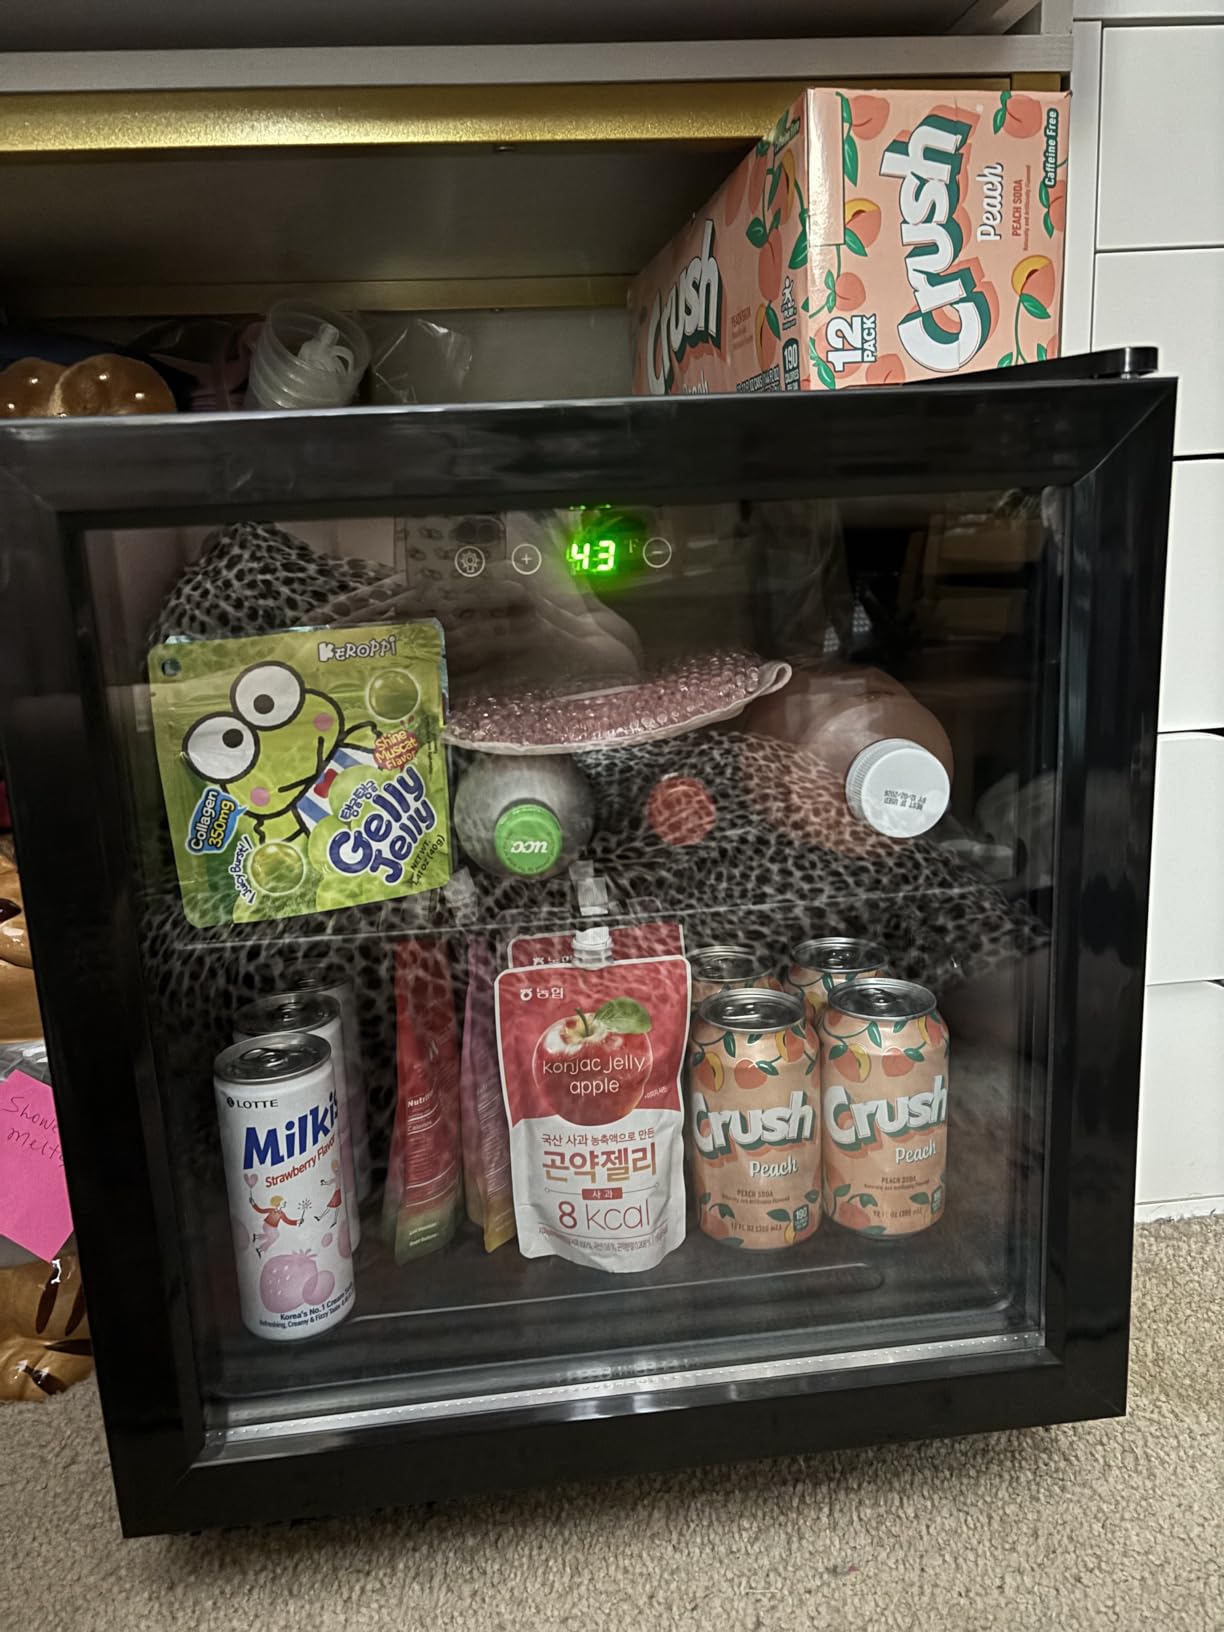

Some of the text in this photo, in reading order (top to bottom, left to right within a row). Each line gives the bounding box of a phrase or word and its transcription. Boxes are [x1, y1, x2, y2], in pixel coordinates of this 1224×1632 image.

[1045, 110, 1058, 187] Caffeine Free
[976, 162, 1004, 242] Peach
[1012, 179, 1023, 237] PEACH SODA
[879, 113, 982, 372] Crush
[647, 219, 721, 395] Crush
[826, 316, 863, 373] 12
[862, 314, 877, 362] PACK
[784, 344, 798, 371] 190
[570, 539, 616, 571] 43
[375, 729, 408, 751] Shine
[376, 735, 419, 764] Muscat
[385, 752, 417, 770] Flavor
[188, 789, 219, 851] Collagen
[207, 799, 236, 848] 350mg
[328, 766, 426, 874] Gelly
[369, 798, 437, 885] Jelly
[411, 854, 422, 870] NET
[542, 1054, 646, 1077] konjac jelly
[236, 1098, 279, 1110] LOTTE
[569, 1077, 620, 1096] apple
[1, 1096, 58, 1133] Showe
[692, 1090, 814, 1153] Crush
[823, 1075, 948, 1144] Crush
[542, 1127, 655, 1147] 국산 사과 농축액으로 만든
[895, 1139, 937, 1164] Peach
[265, 1134, 336, 1188] Strawberry Flavor
[542, 1142, 657, 1184] 곤약젤리
[750, 1156, 798, 1177] Peach
[558, 1198, 650, 1231] 8 kcal
[281, 1310, 308, 1321] Korea's
[315, 1311, 329, 1321] Fizzy
